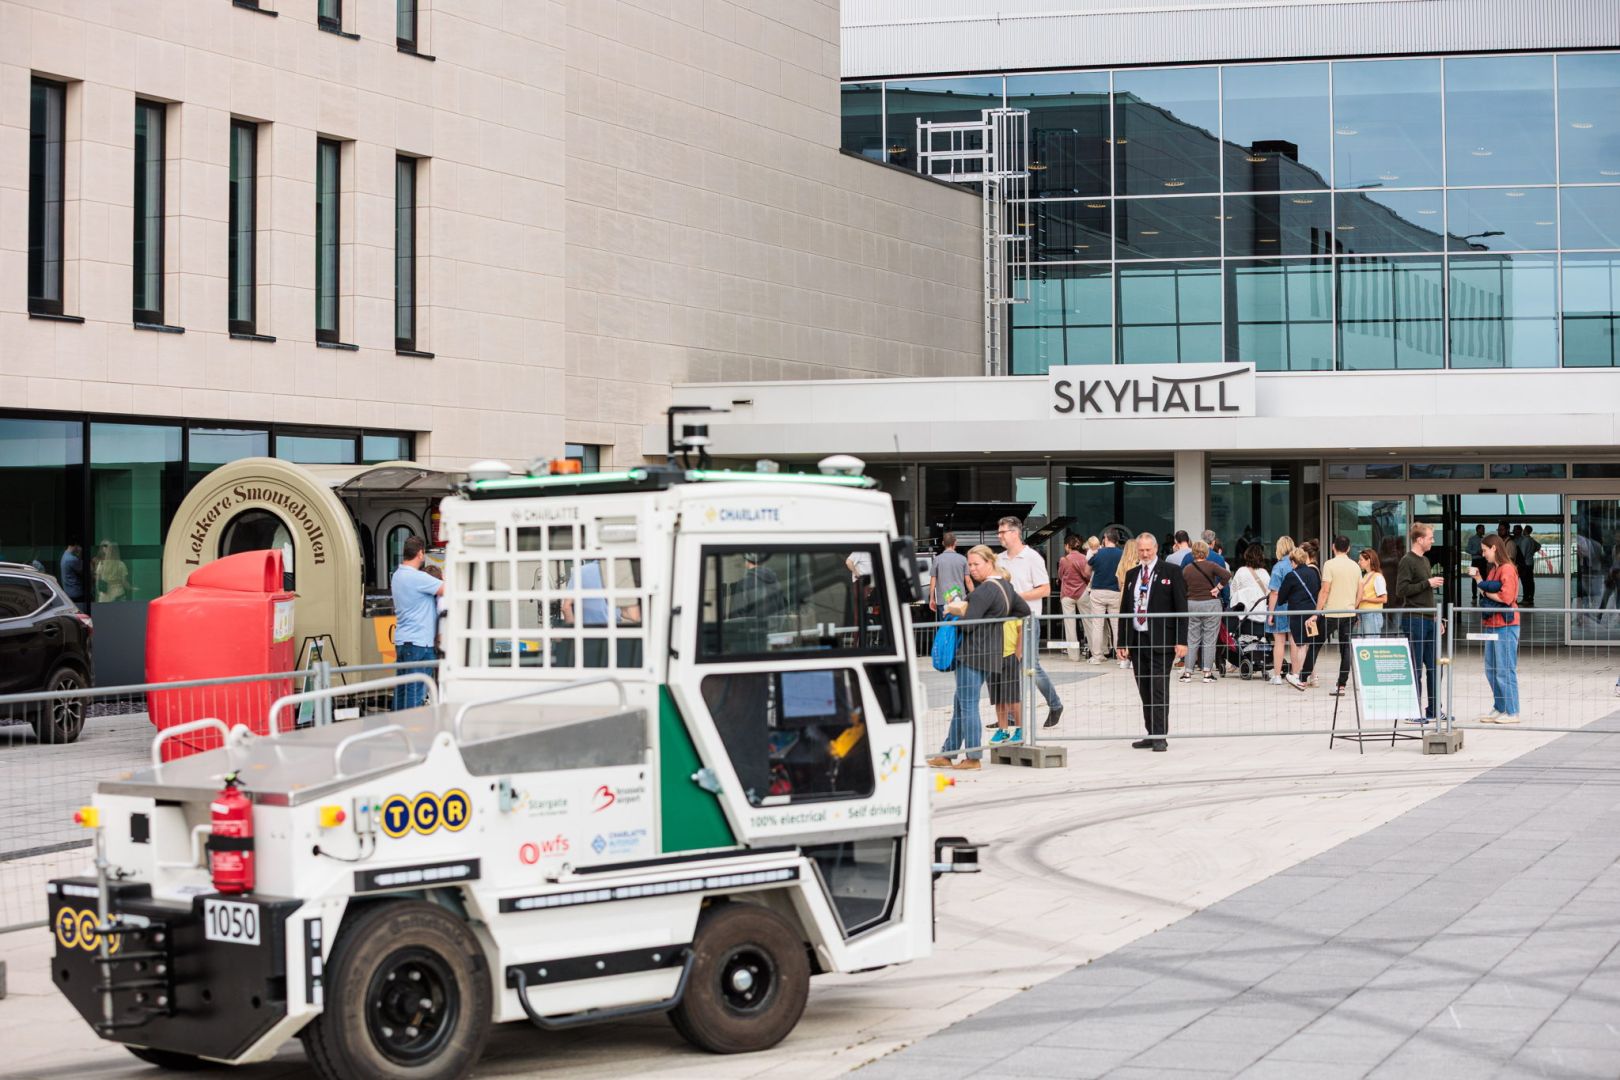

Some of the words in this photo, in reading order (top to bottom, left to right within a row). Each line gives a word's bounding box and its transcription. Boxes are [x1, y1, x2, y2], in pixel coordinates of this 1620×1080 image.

[1053, 371, 1245, 414] SKYHALL
[185, 496, 232, 566] Lekkere
[233, 485, 326, 565] Smoutebollen
[719, 508, 780, 521] CHARLATTE
[385, 795, 467, 832] TCR
[751, 815, 777, 827] 100%
[780, 810, 826, 825] electrical
[848, 806, 869, 819] Self
[870, 804, 902, 817] driving
[541, 834, 569, 852] wfs
[59, 912, 118, 949] TC
[208, 905, 256, 939] 1050
